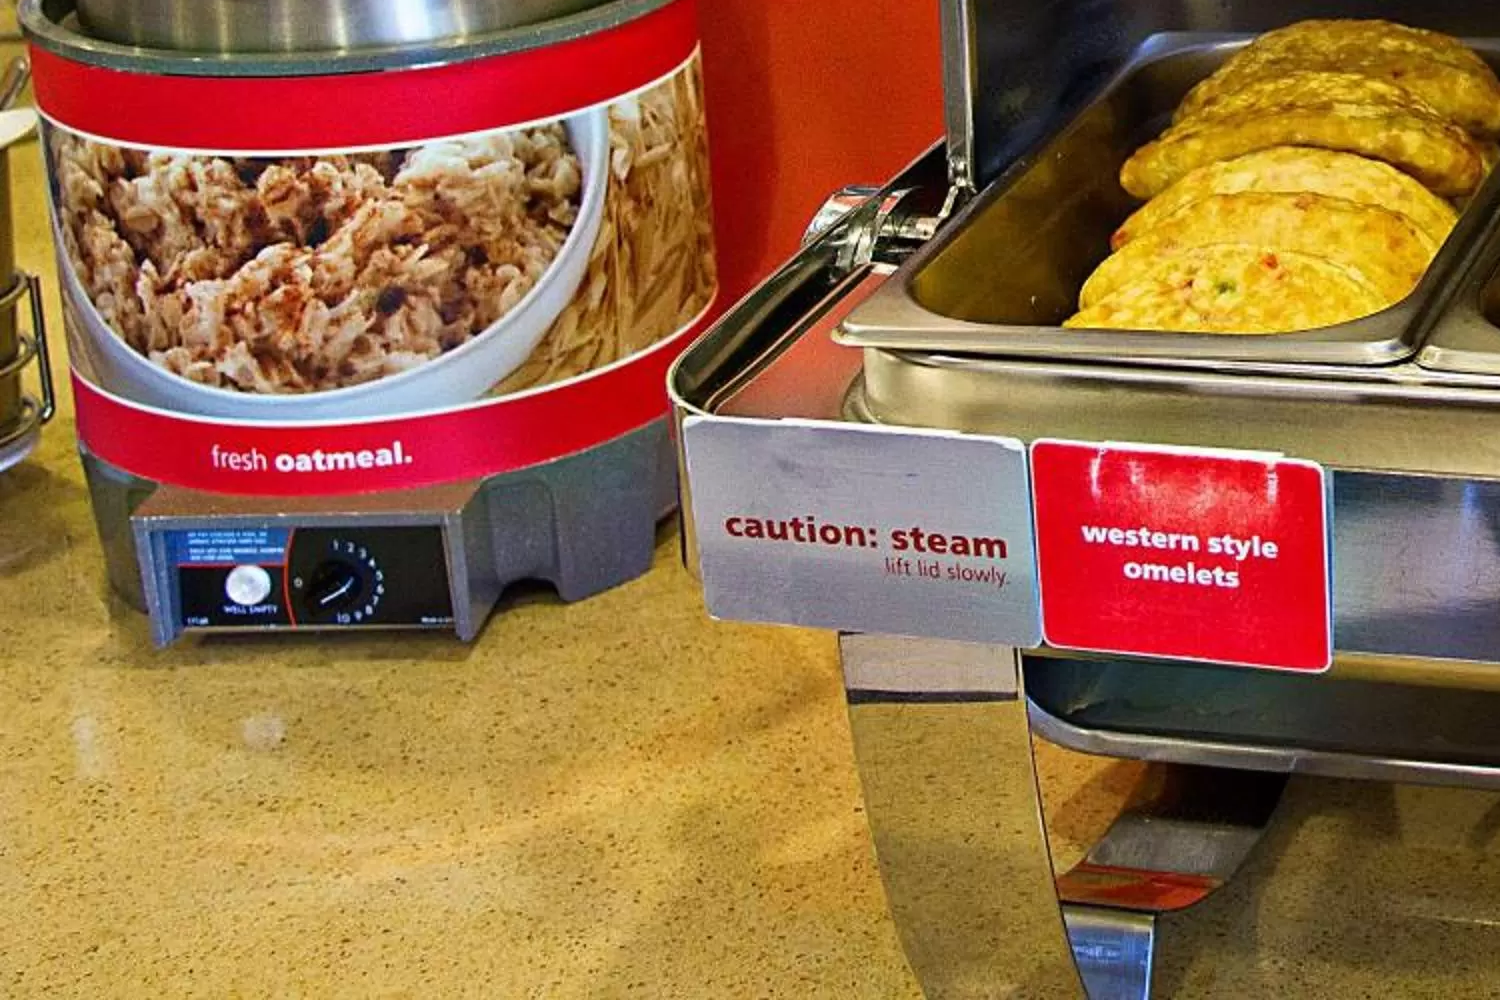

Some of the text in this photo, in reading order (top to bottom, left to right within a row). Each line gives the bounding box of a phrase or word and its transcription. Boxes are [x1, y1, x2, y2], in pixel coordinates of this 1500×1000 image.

[211, 440, 413, 472] fresh oatmeal.
[725, 516, 1008, 559] caution: steam
[1081, 525, 1279, 561] western style
[885, 557, 1011, 587] lift lid slowly.
[1123, 561, 1240, 588] omelets
